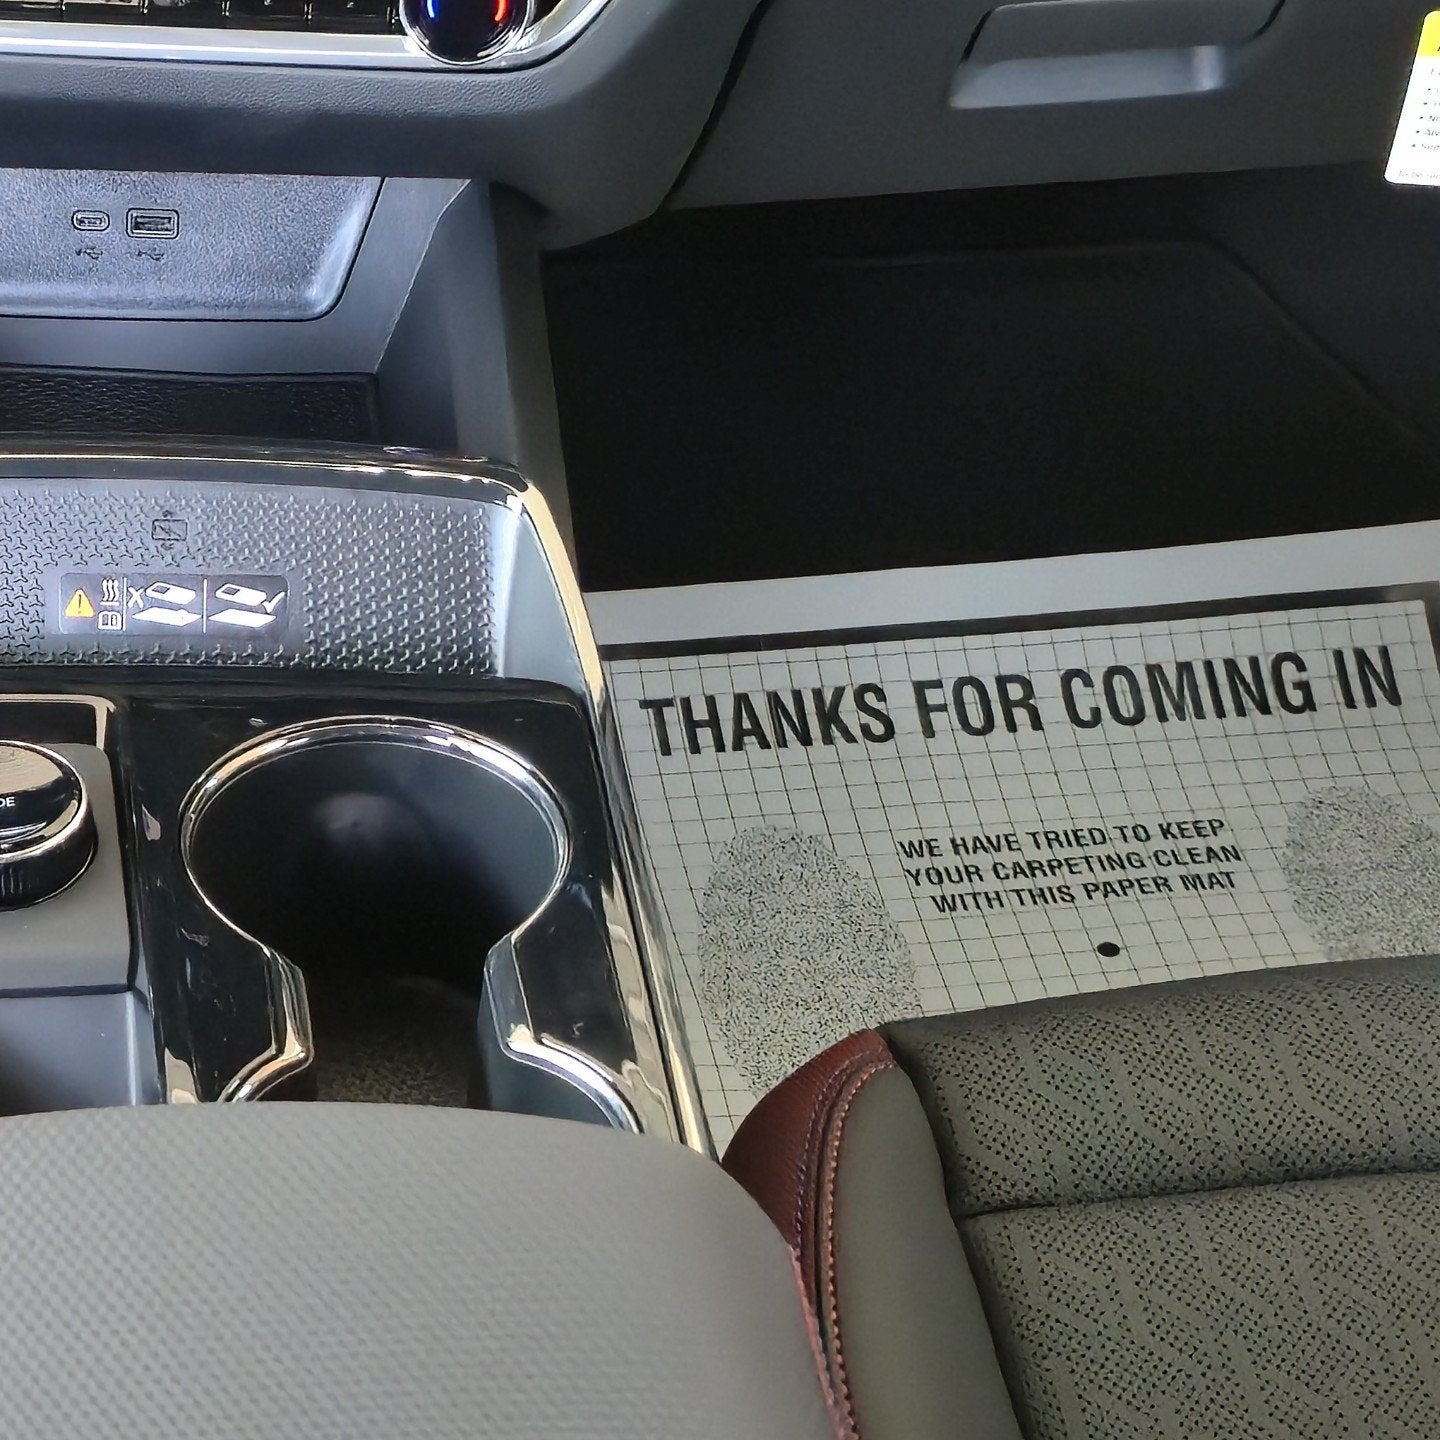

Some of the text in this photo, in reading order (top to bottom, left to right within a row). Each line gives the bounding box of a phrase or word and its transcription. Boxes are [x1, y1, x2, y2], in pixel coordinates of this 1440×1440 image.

[638, 644, 1403, 757] THANKS FOR COMING IN
[898, 818, 1225, 859] WE HAVE TRIED TO KEEP
[904, 845, 1243, 888] YOUR CARPETING CLEAN
[930, 871, 1236, 914] WITH THIS PAPER MAT
